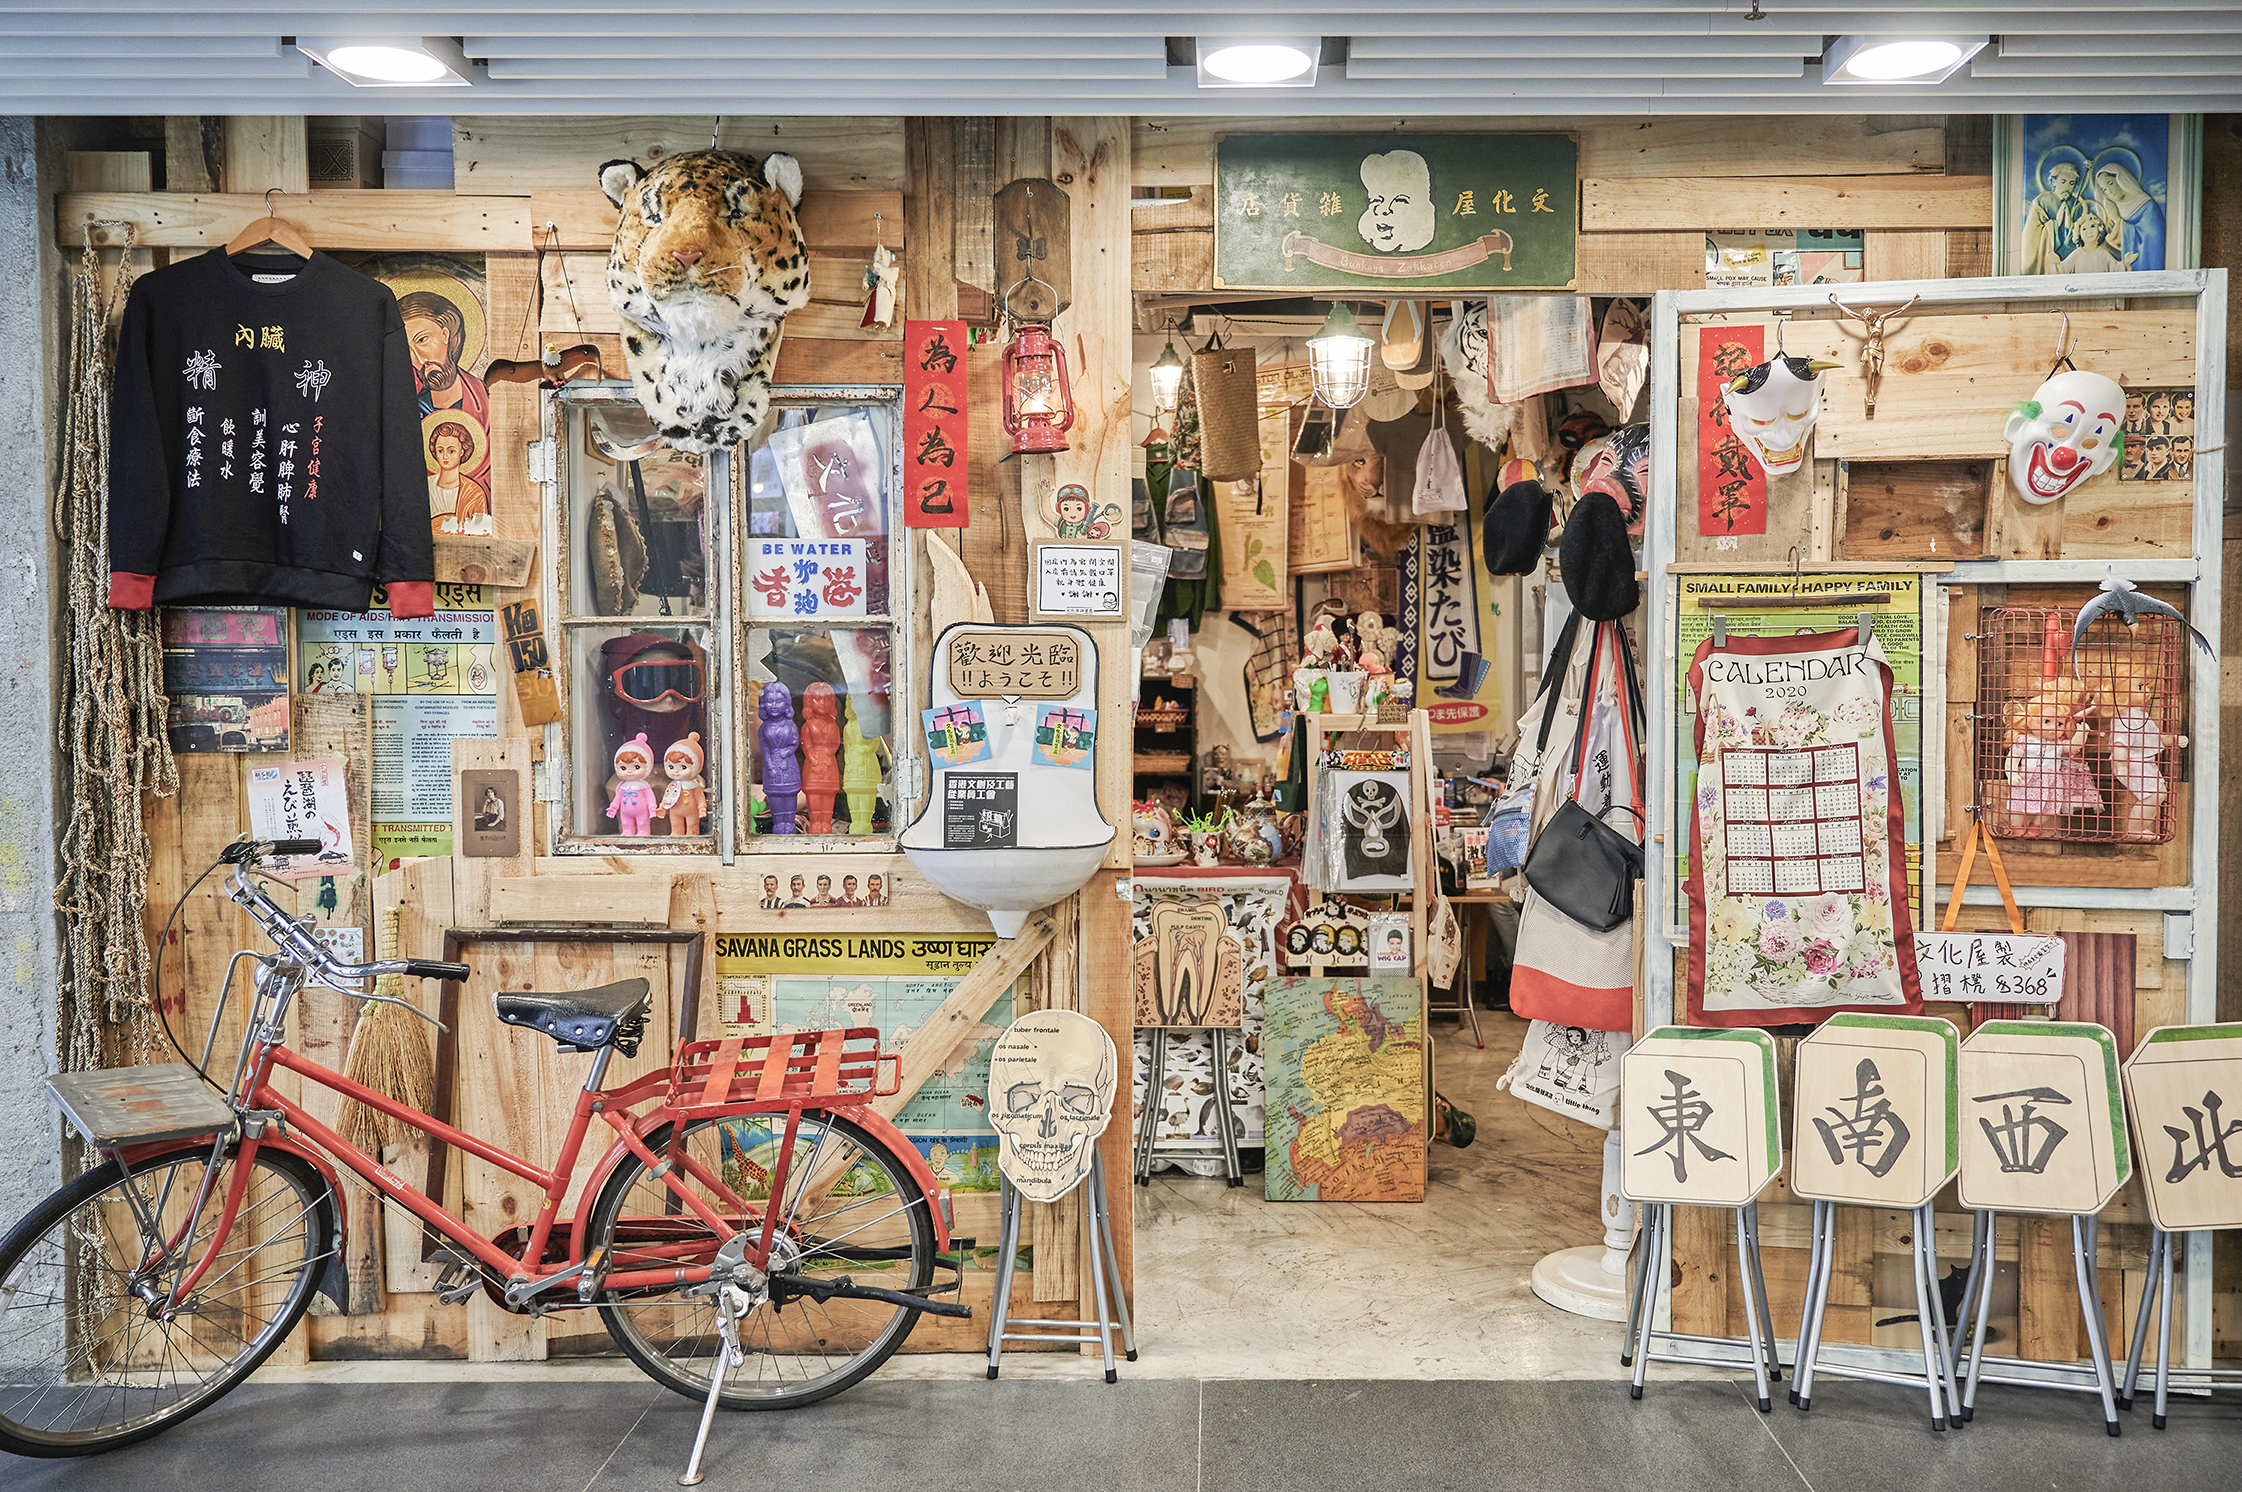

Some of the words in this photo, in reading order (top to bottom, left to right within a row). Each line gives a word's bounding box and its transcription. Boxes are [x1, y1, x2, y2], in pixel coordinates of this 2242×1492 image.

[1340, 255, 1384, 273] Bunkaya
[1397, 256, 1452, 273] Zakkaten
[916, 334, 958, 514] 為人為己
[186, 406, 206, 488] 斷食療法
[220, 417, 236, 480] 飲暖水
[304, 415, 325, 500] 子宮健康
[762, 544, 784, 555] BE
[791, 544, 852, 555] WATER
[1686, 582, 1735, 594] SMALL
[1737, 583, 1791, 594] FAMILY
[1802, 582, 1852, 594] HAPPY
[1857, 580, 1913, 592] FAMILY
[306, 612, 340, 622] MODE
[342, 612, 357, 622] OF
[954, 640, 1074, 667] 歡迎光臨
[1708, 652, 1867, 686] CALENDAR
[1765, 686, 1807, 699] 2020
[297, 770, 316, 820] 琵琶湖の
[382, 824, 446, 832] TRANSMITTED
[1258, 887, 1284, 896] WORLD
[716, 938, 780, 958] SAVANA
[783, 938, 842, 958] GRASS
[848, 939, 905, 958] LANDS
[1916, 938, 2017, 968] 文化屋製
[1582, 1103, 1600, 1115] thing
[1812, 1058, 1912, 1178] 南
[1634, 1069, 1737, 1183] 東
[1972, 1086, 2072, 1174] 西
[2162, 1089, 2242, 1184] 北
